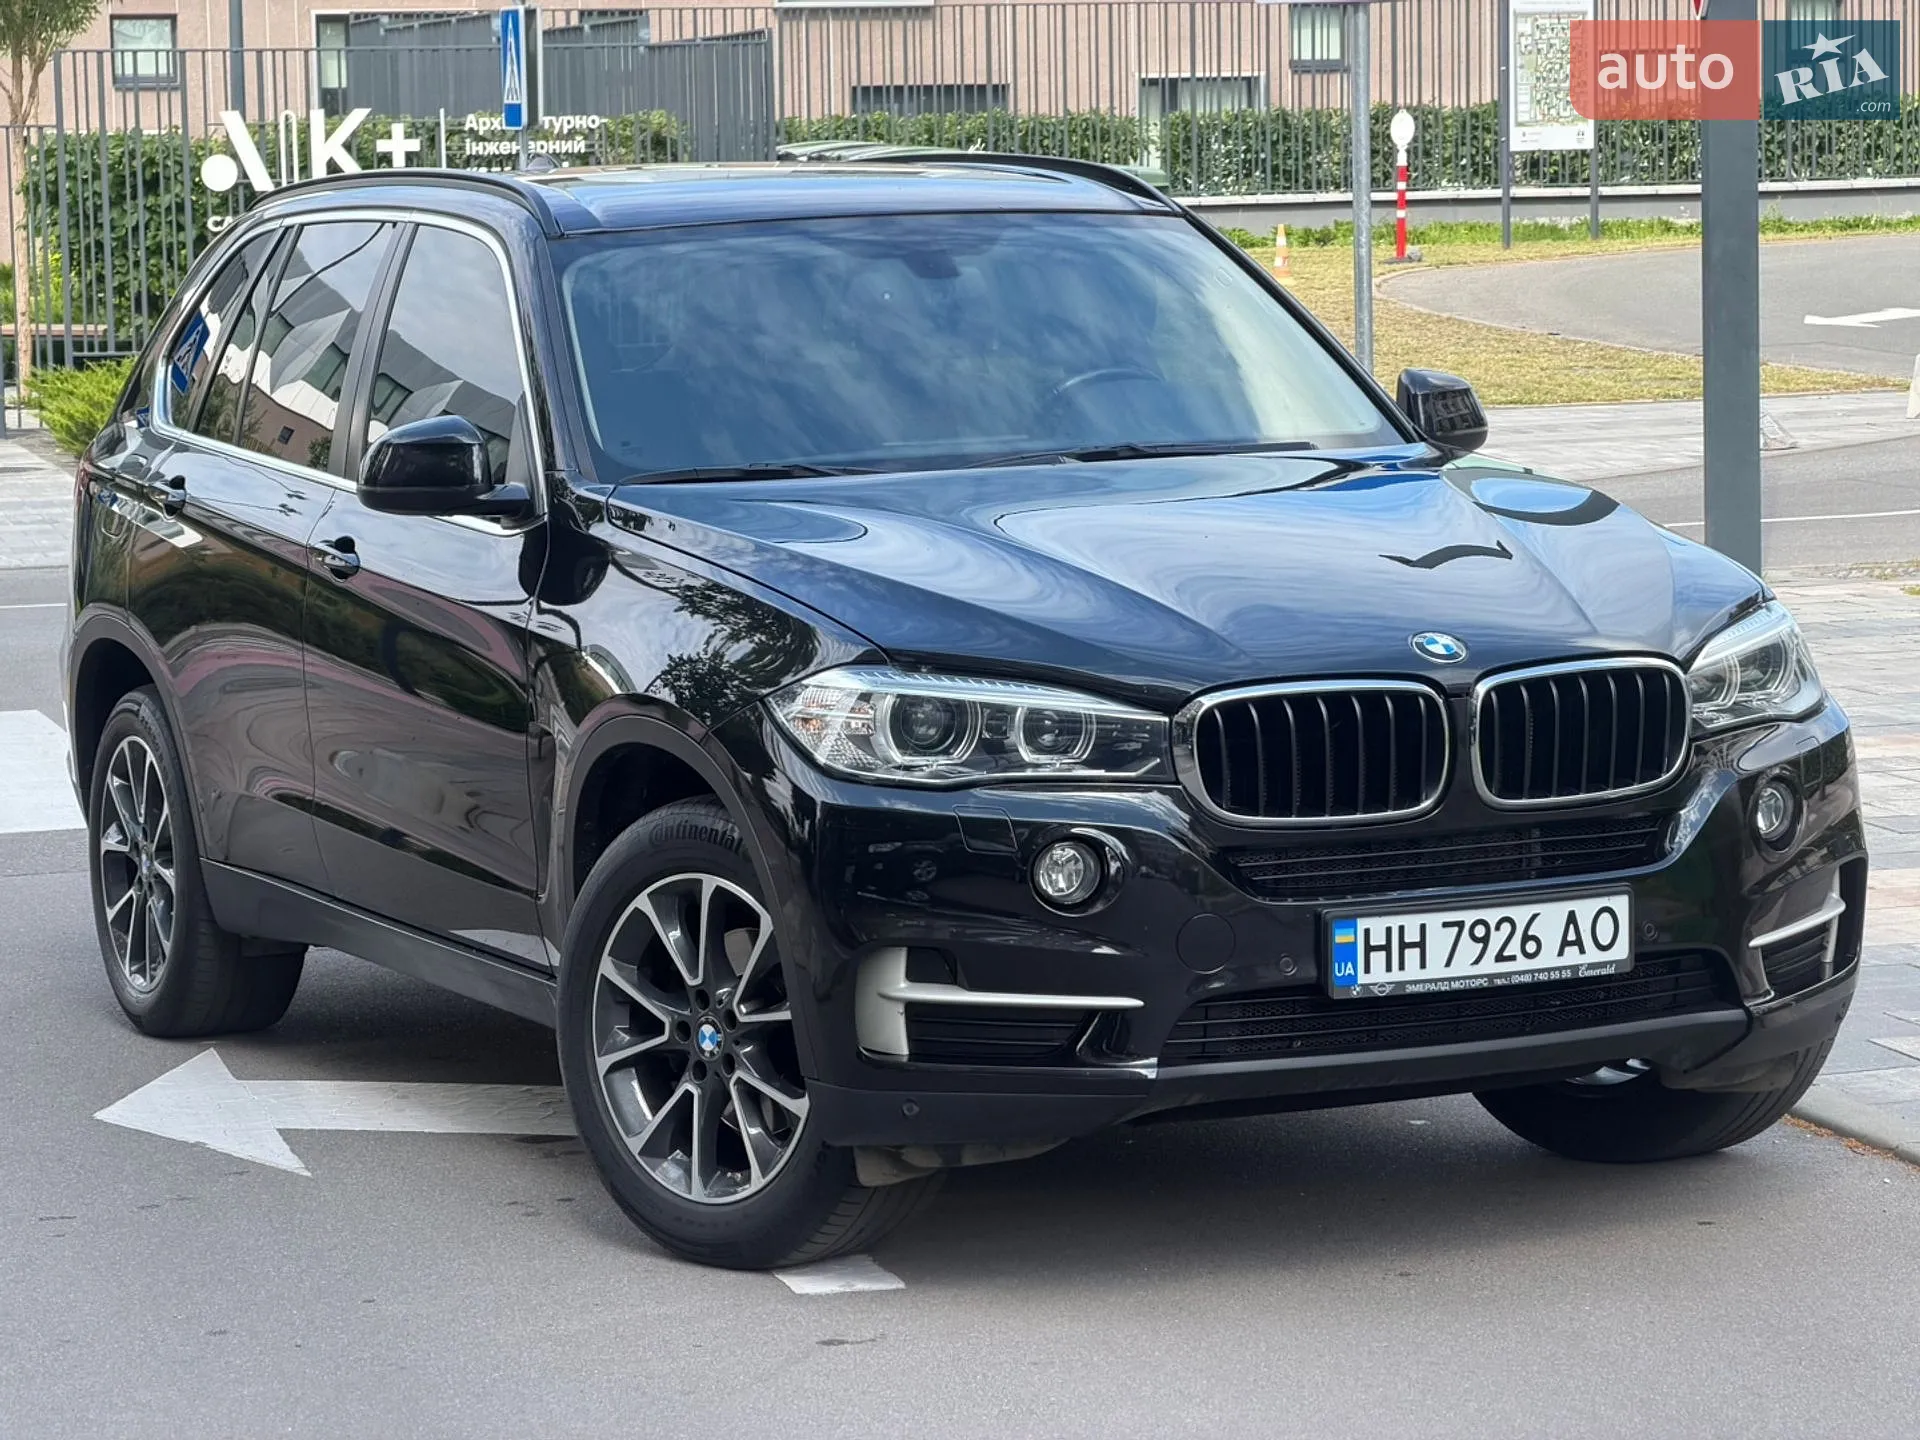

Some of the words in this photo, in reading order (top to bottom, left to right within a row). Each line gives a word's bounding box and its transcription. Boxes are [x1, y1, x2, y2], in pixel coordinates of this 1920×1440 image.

[1363, 922, 1427, 975] HH
[1441, 912, 1543, 968] 7926
[1556, 905, 1620, 957] AO
[1334, 961, 1355, 977] UA
[1578, 963, 1616, 978] Emerald
[1405, 980, 1451, 993] ЭМЕРАЛД
[1451, 977, 1488, 989] МОТОРС
[1534, 971, 1549, 981] 740
[1550, 970, 1560, 979] 55
[1561, 968, 1572, 978] 55
